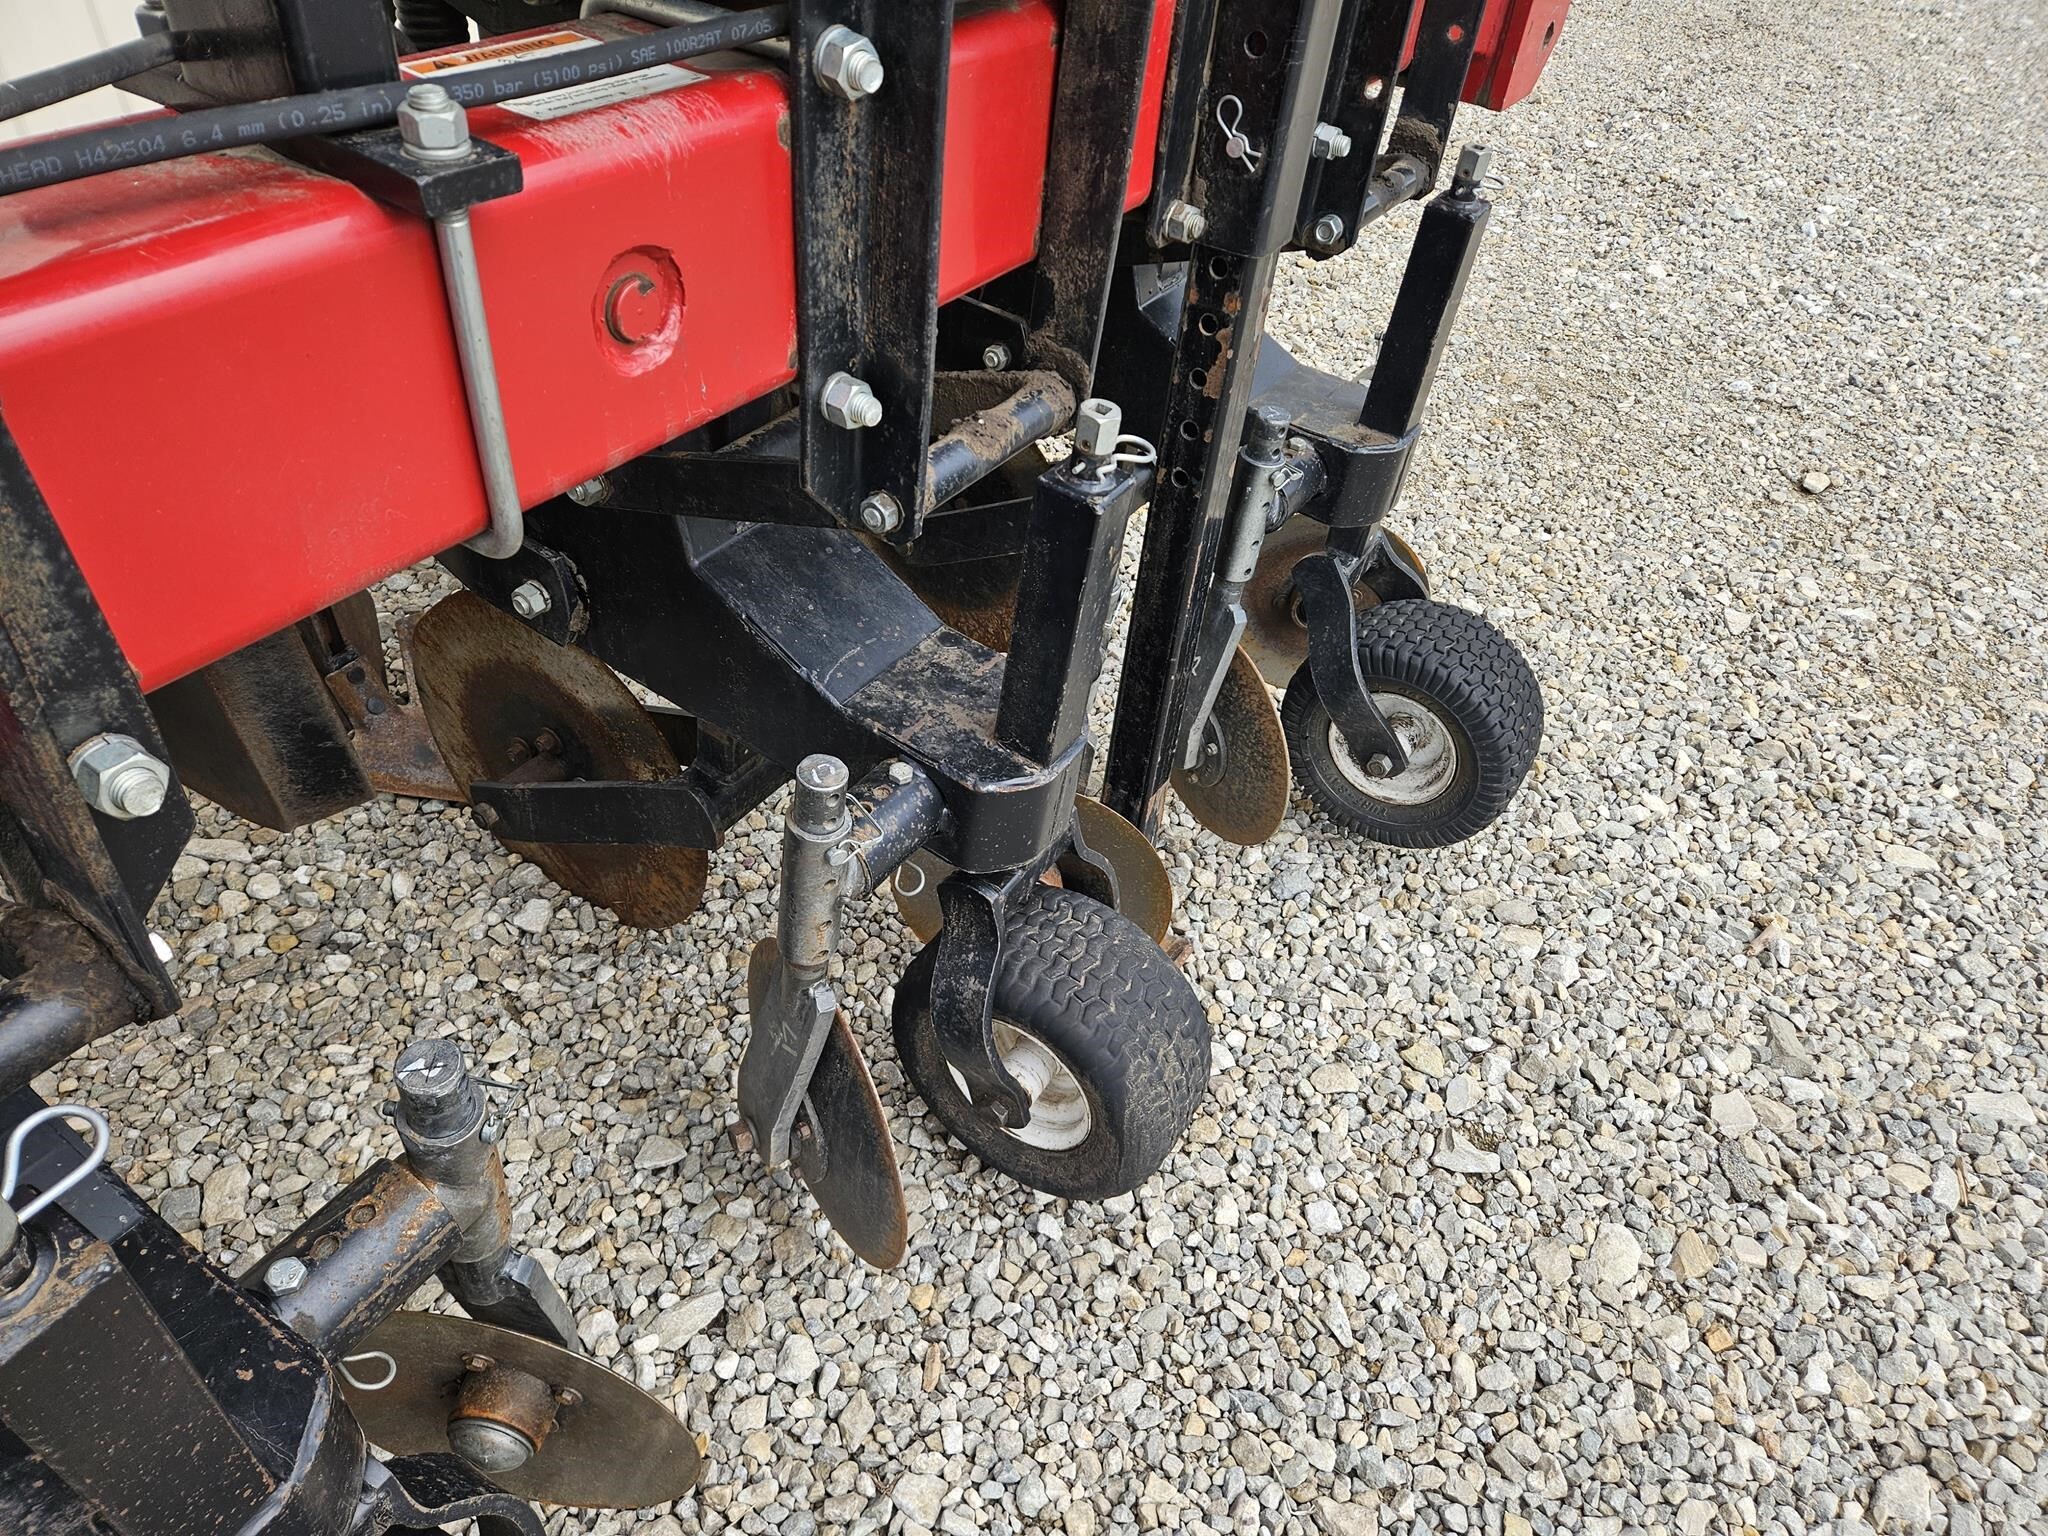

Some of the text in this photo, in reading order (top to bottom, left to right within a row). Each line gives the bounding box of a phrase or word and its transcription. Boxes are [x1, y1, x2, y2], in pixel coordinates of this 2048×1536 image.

[77, 133, 166, 169] H42504
[238, 121, 265, 138] mm
[278, 103, 346, 129] (0.25
[361, 95, 393, 118] in)
[494, 79, 523, 96] bar
[533, 65, 580, 88] (5100
[588, 54, 623, 75] psi)
[631, 45, 656, 65] SAE
[666, 30, 722, 57] 100R2AT
